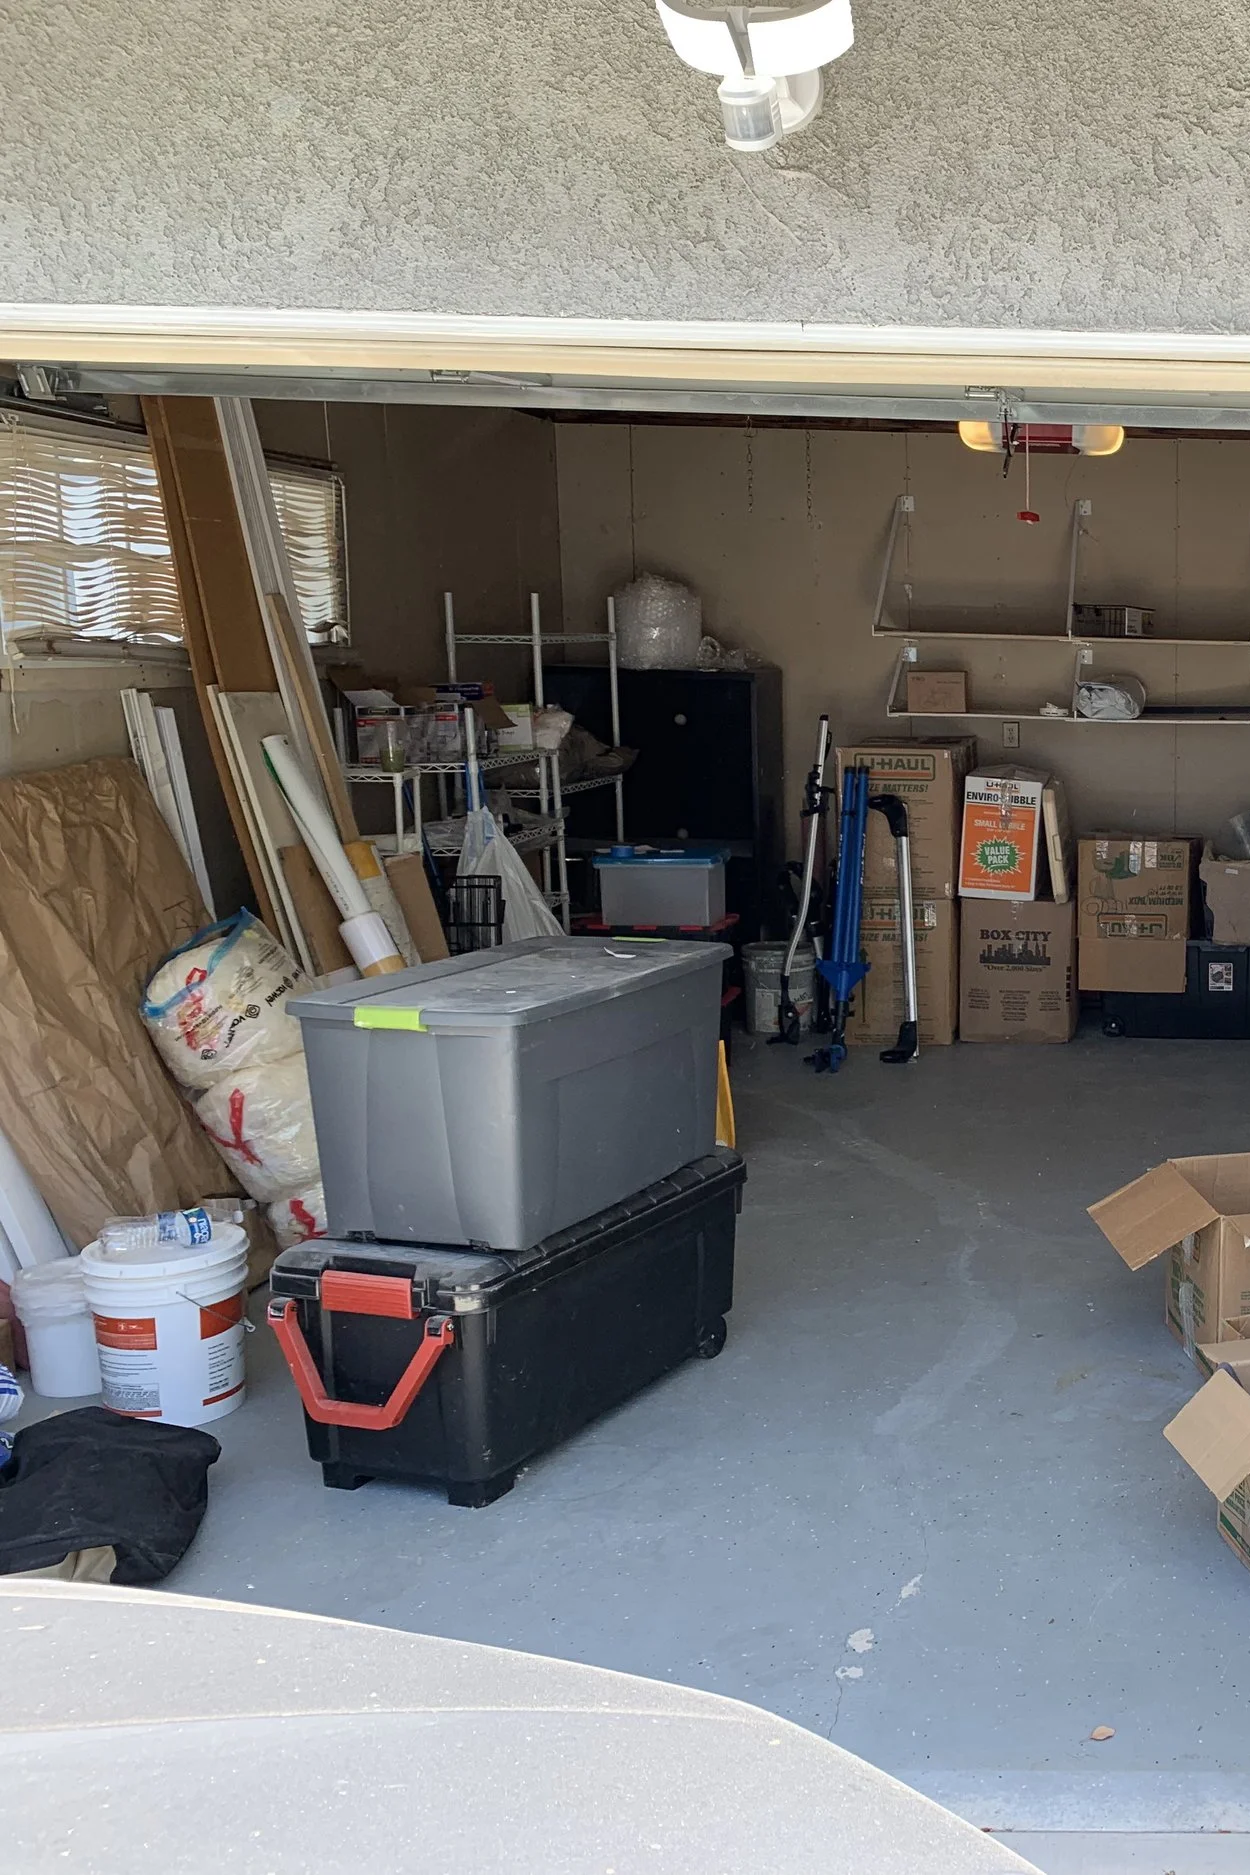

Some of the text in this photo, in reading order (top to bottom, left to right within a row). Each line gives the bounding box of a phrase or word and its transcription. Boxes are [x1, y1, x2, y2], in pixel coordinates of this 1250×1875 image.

[859, 757, 931, 771] U-HAUL
[984, 846, 1011, 856] VALUE
[987, 855, 1009, 865] PACK
[979, 929, 1052, 942] BOX CITY
